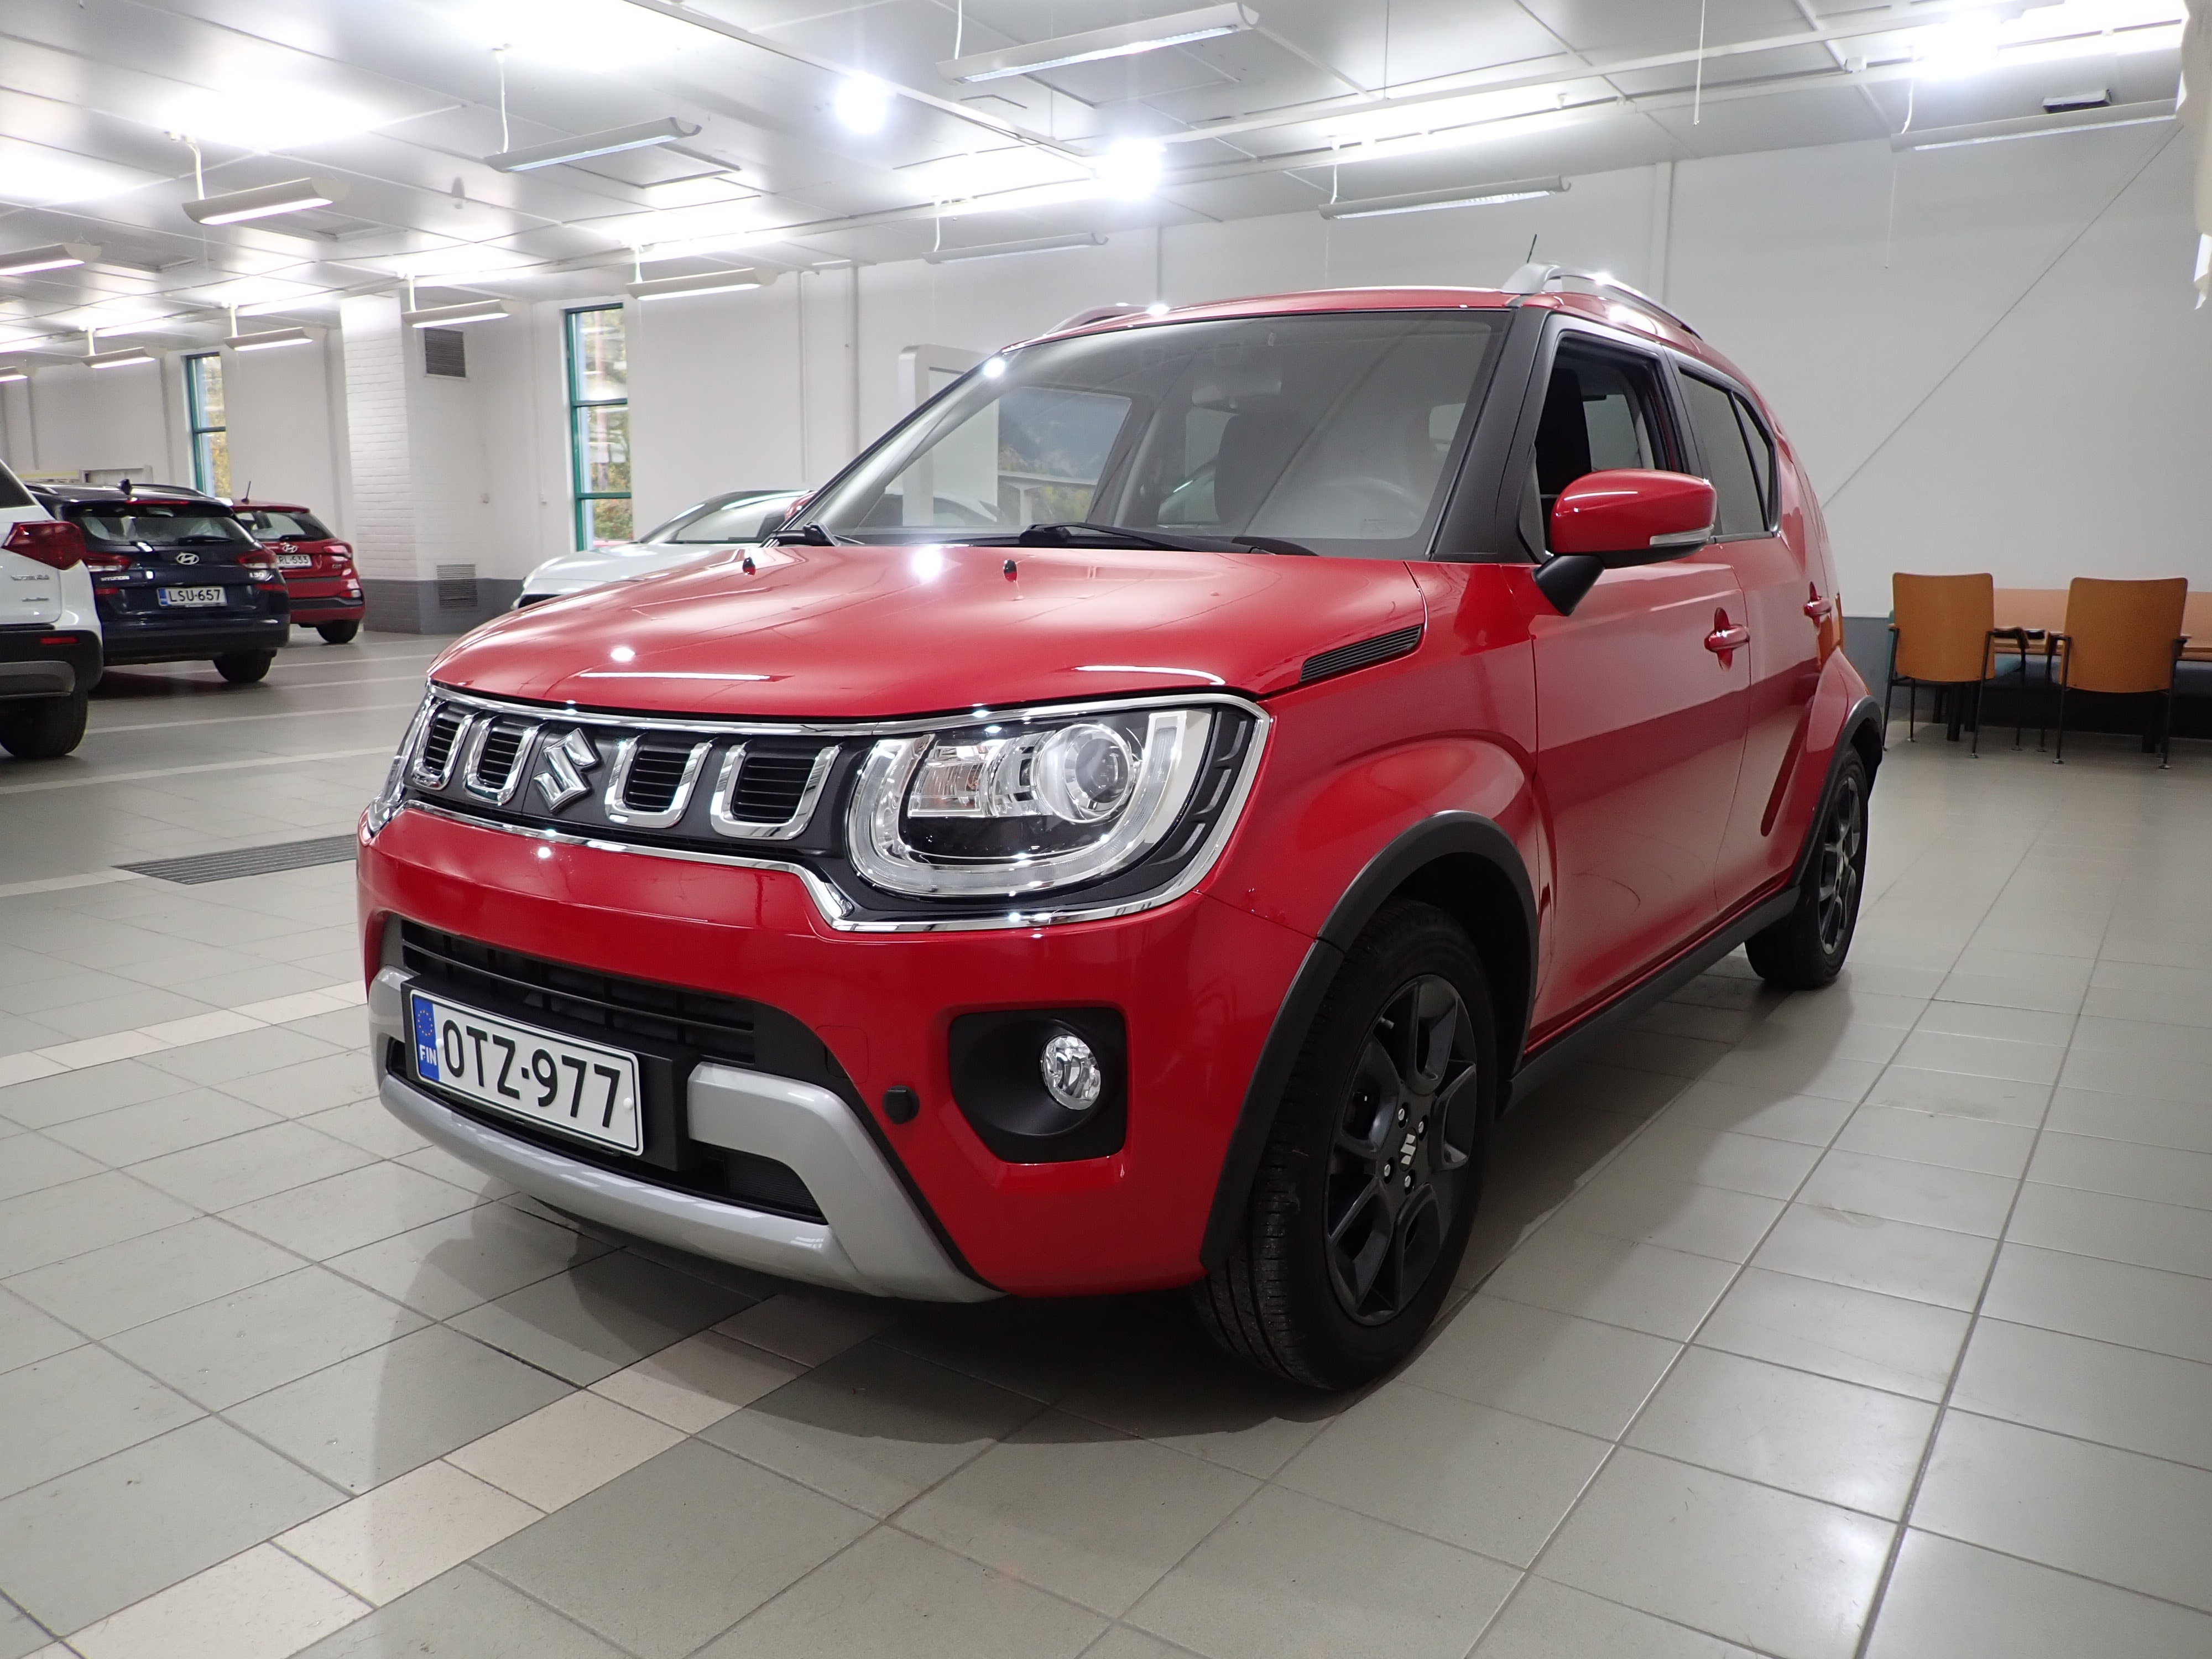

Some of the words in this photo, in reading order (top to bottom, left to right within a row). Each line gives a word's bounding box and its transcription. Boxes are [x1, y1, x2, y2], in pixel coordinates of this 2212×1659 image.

[276, 555, 309, 565] RL-533
[168, 589, 221, 602] LSU-657
[419, 1044, 437, 1066] FIN
[443, 1019, 620, 1128] OTZ-977
